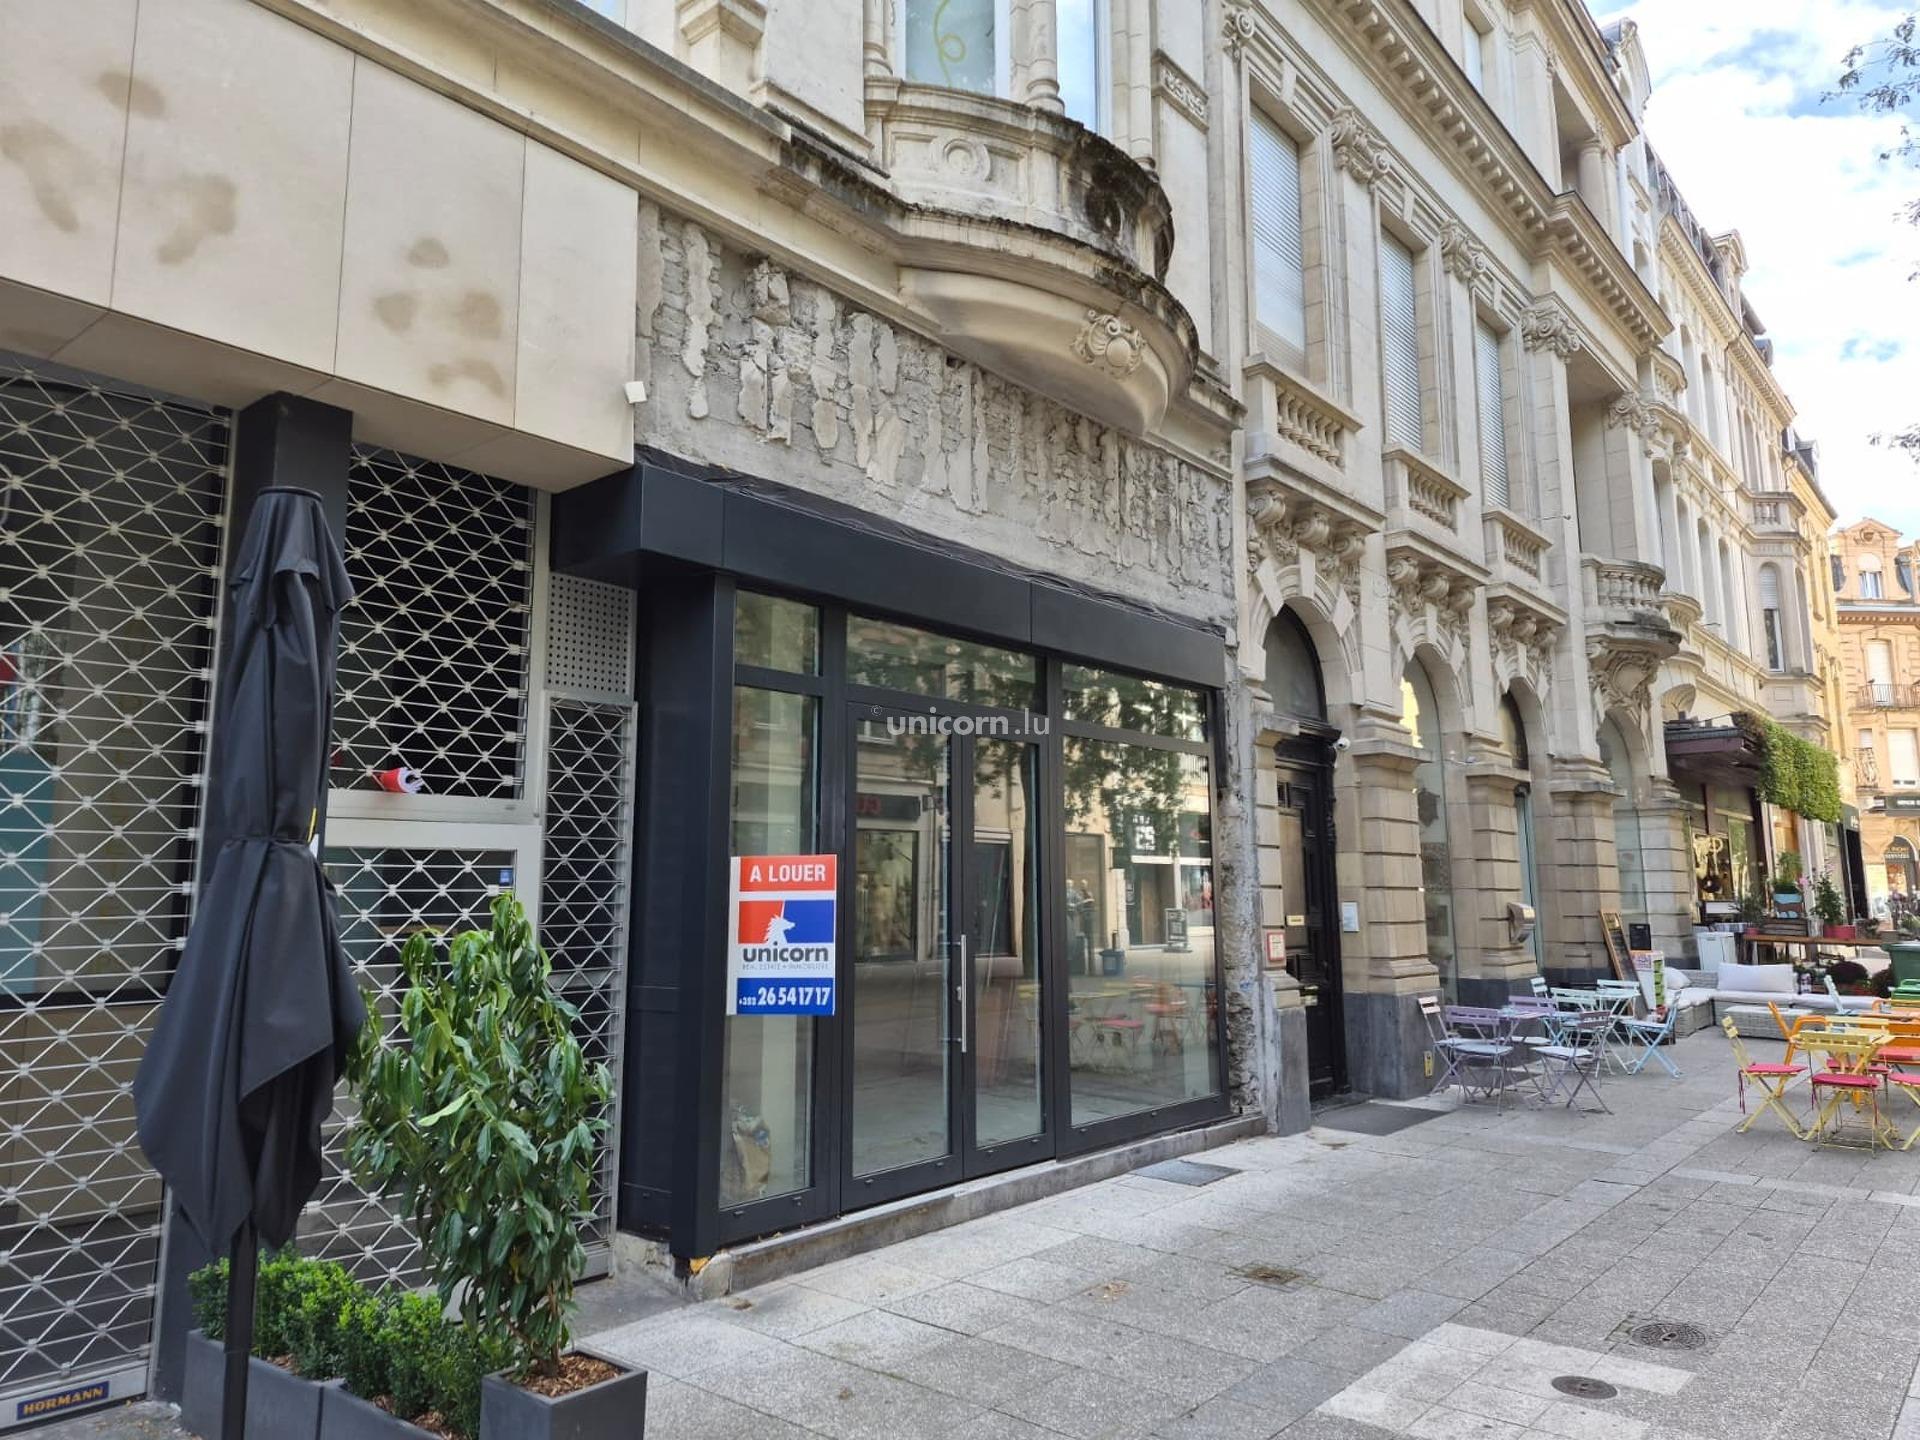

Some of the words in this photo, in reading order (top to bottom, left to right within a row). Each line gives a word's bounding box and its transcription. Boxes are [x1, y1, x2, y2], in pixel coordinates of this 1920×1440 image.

[749, 864, 763, 883] A
[768, 863, 826, 882] LOUER
[742, 941, 829, 963] unicorn
